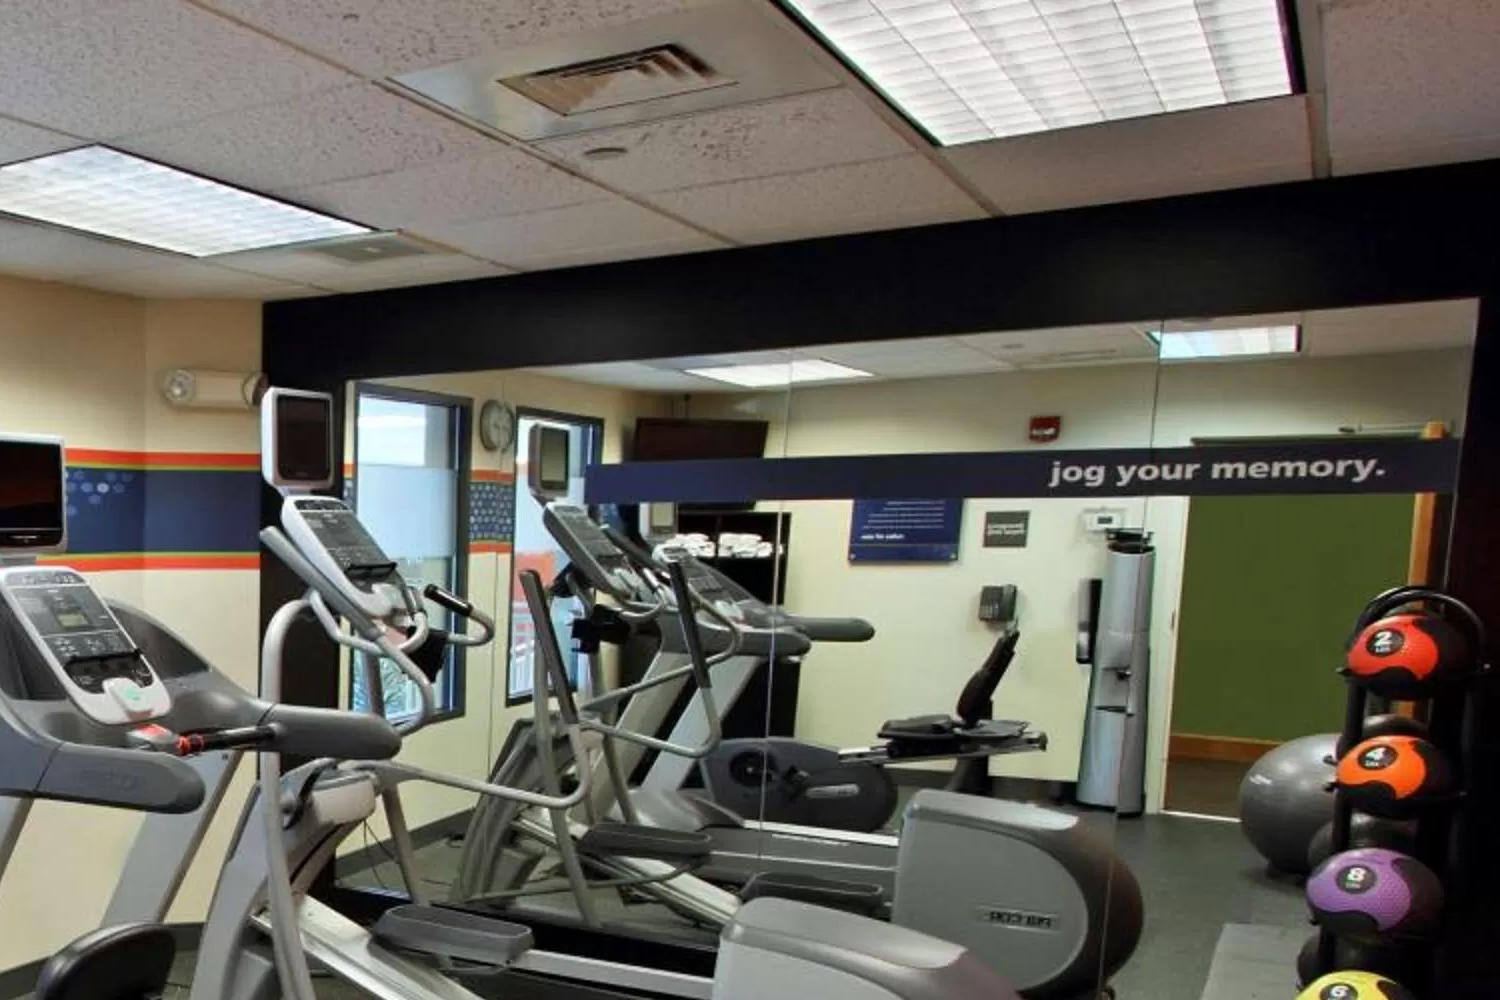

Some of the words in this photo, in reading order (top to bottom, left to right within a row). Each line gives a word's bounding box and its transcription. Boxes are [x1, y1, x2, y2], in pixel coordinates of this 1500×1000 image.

[1048, 459, 1106, 488] jog
[1115, 463, 1201, 487] your
[1211, 458, 1386, 483] memory.
[1374, 631, 1393, 646] 2
